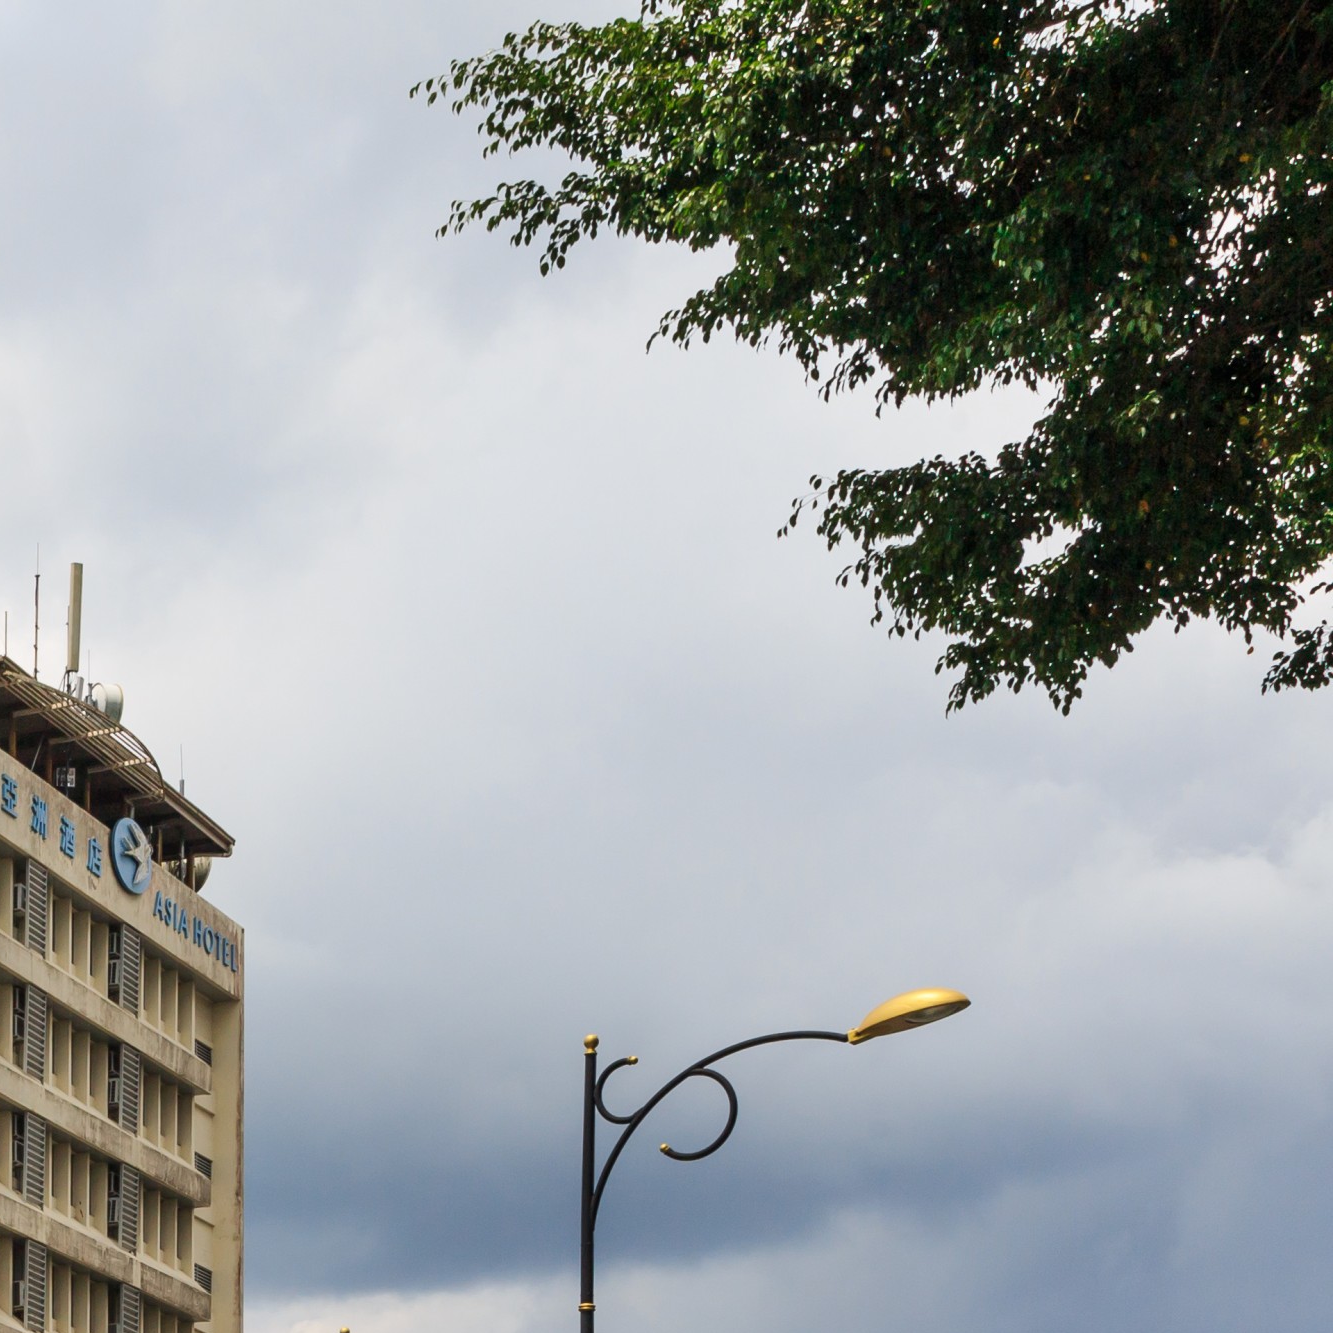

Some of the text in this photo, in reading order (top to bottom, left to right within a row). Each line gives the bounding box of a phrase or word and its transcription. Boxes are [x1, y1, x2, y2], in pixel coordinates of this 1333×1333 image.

[0, 773, 102, 878] 亞洲酒店
[153, 890, 238, 973] ASIA HOTEL
